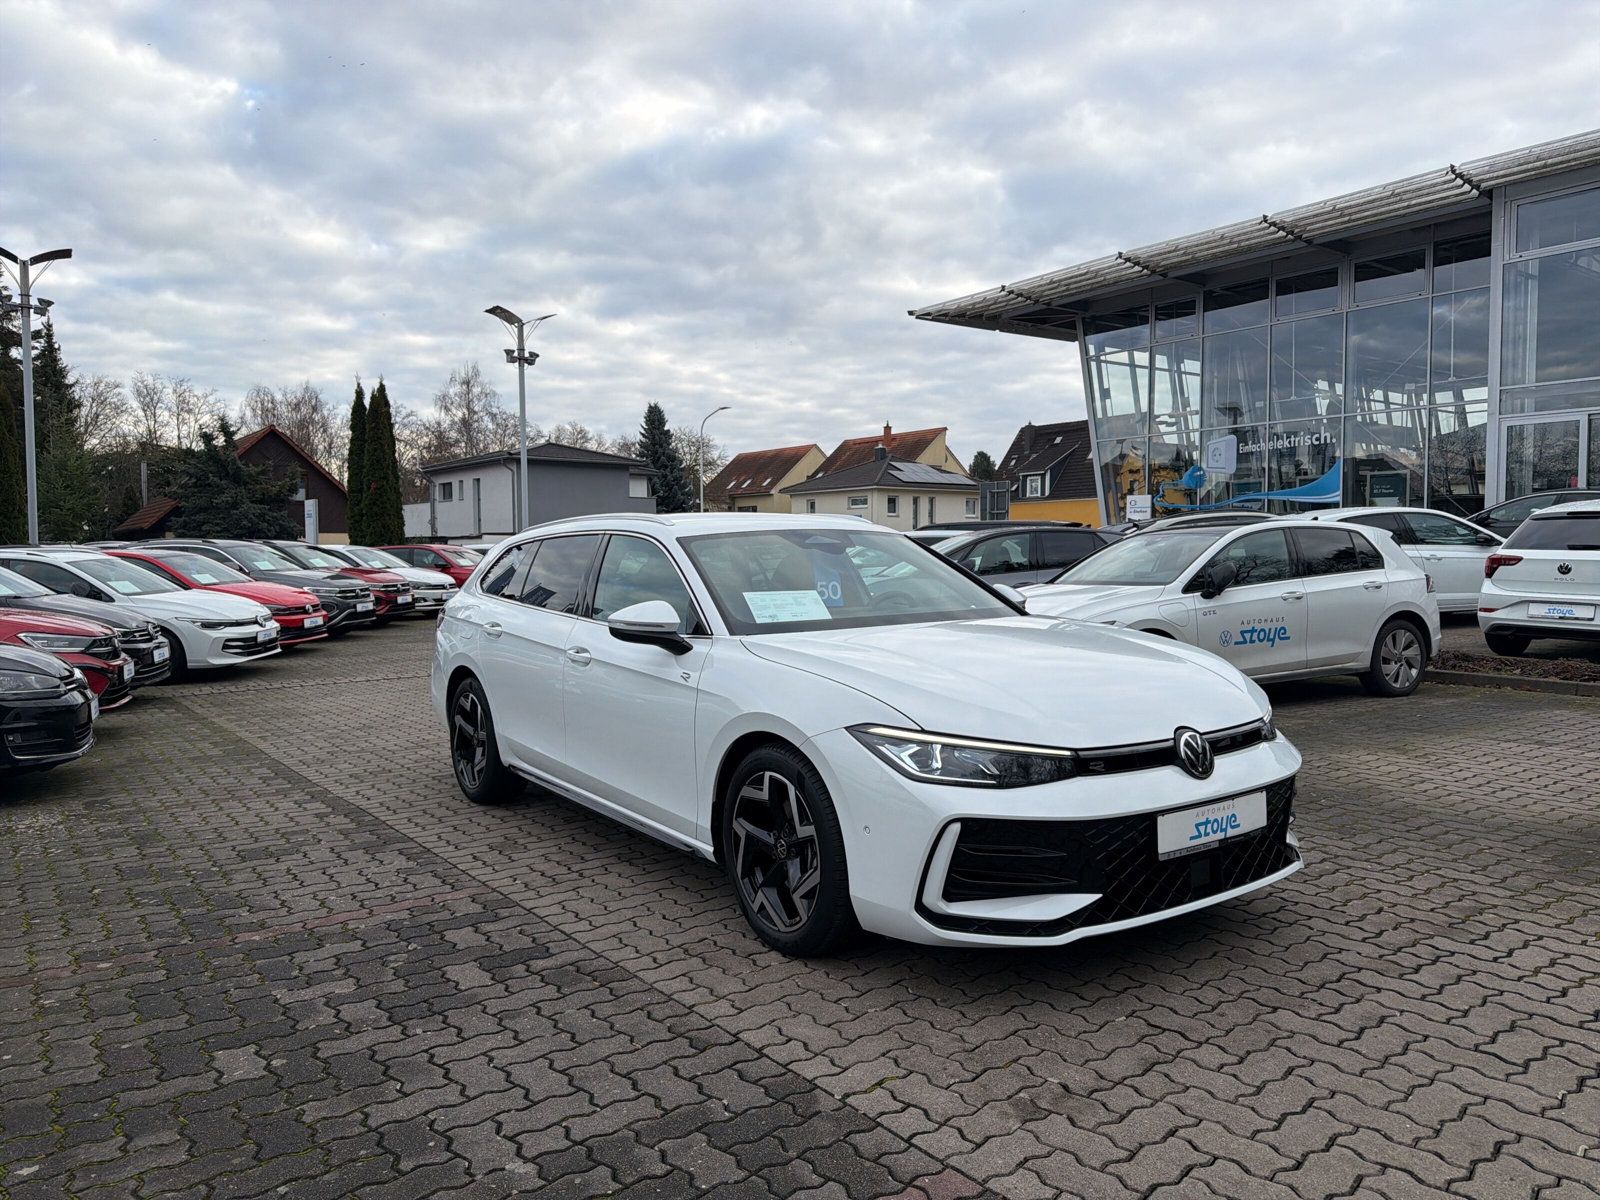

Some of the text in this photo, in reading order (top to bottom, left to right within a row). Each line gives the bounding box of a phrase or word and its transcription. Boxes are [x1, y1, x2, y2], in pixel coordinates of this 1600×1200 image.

[1239, 426, 1337, 454] Einfach elektrisch.
[816, 581, 842, 600] 50
[1240, 616, 1286, 626] AUTOHAUS
[1544, 607, 1576, 616] stoye
[1234, 625, 1291, 648] stoye
[1195, 802, 1236, 819] AUTOHAUS
[1189, 813, 1241, 841] stoye
